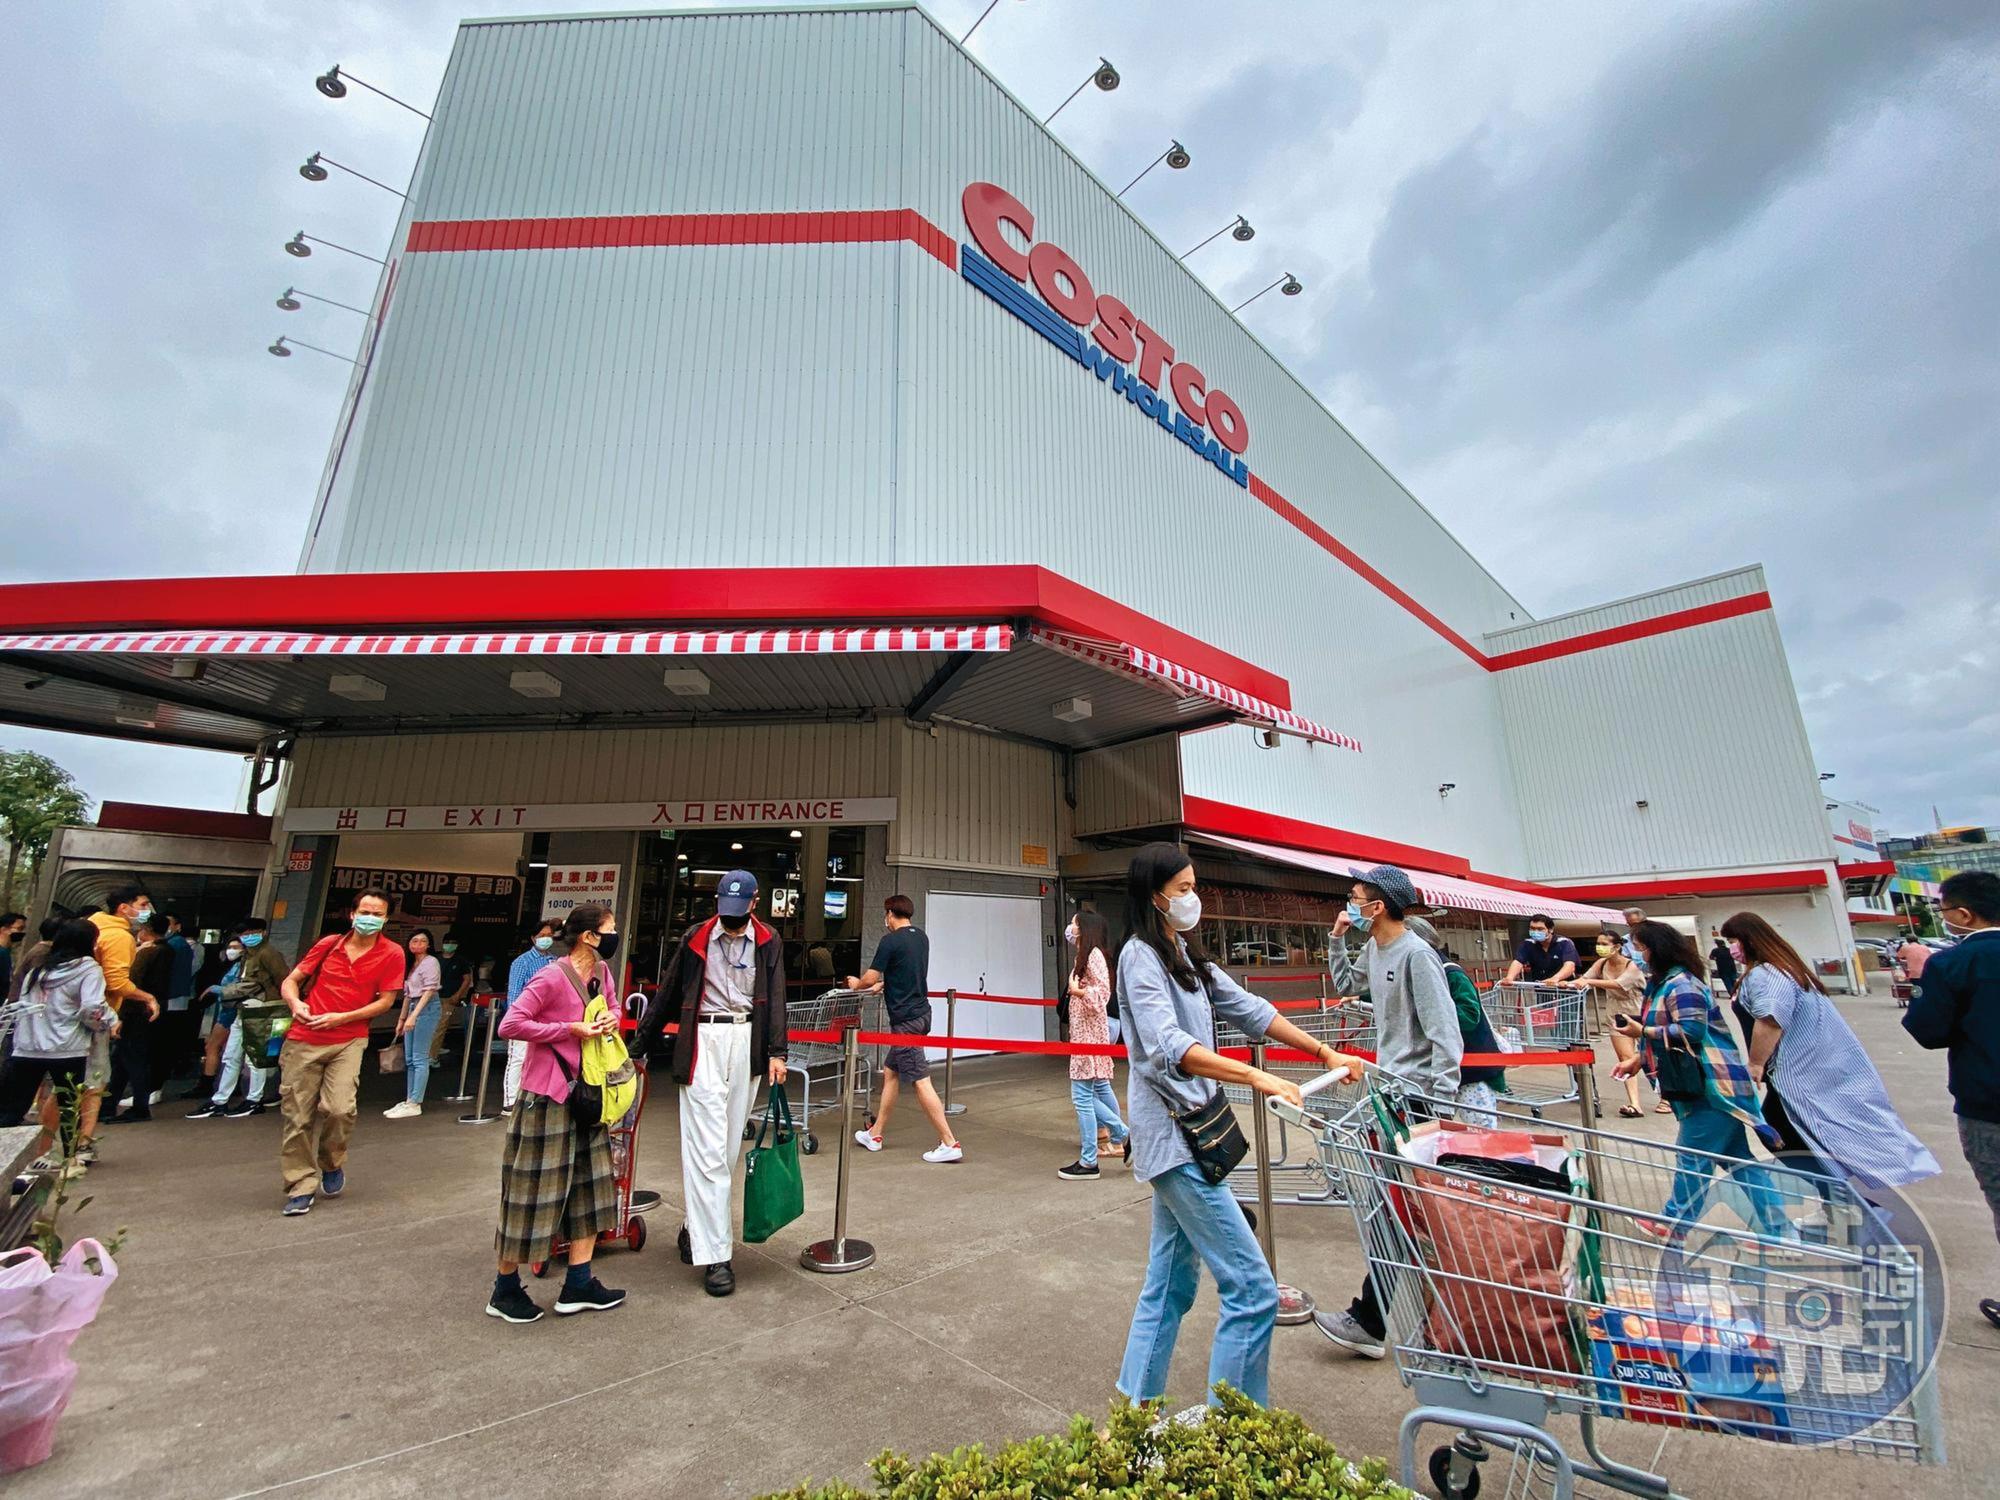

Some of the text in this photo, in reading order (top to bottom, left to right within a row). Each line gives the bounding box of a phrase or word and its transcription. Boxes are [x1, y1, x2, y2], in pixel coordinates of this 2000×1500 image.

[961, 181, 1249, 454] COSTCO
[1075, 331, 1249, 489] WHOLESALE
[336, 807, 527, 830] 出口 EXIT
[651, 801, 844, 823] 入口 ENTRANCE
[290, 861, 309, 870] 268
[331, 868, 513, 896] MBERSHIP 會員部
[550, 870, 616, 884] 營業時間
[549, 885, 589, 893] WAREHOUSE
